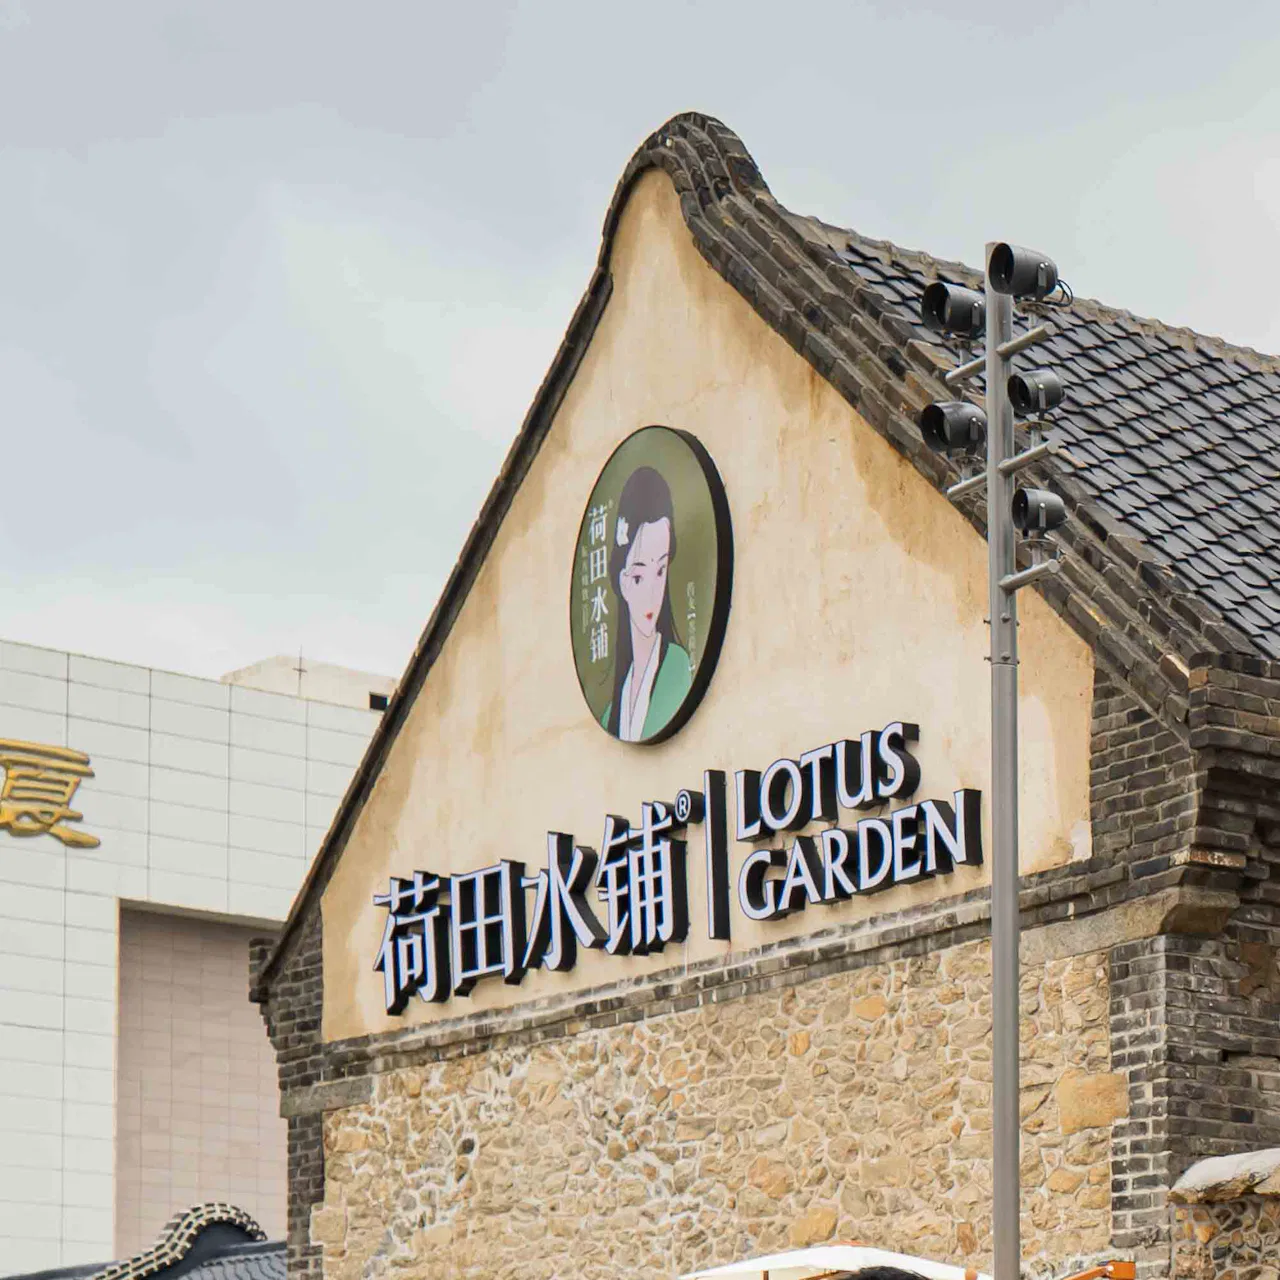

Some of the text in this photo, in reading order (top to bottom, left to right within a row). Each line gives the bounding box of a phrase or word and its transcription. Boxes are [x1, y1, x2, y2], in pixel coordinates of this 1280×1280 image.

[588, 504, 608, 663] 荷田水铺
[734, 721, 920, 842] LOTUS
[738, 789, 983, 921] GARDEN
